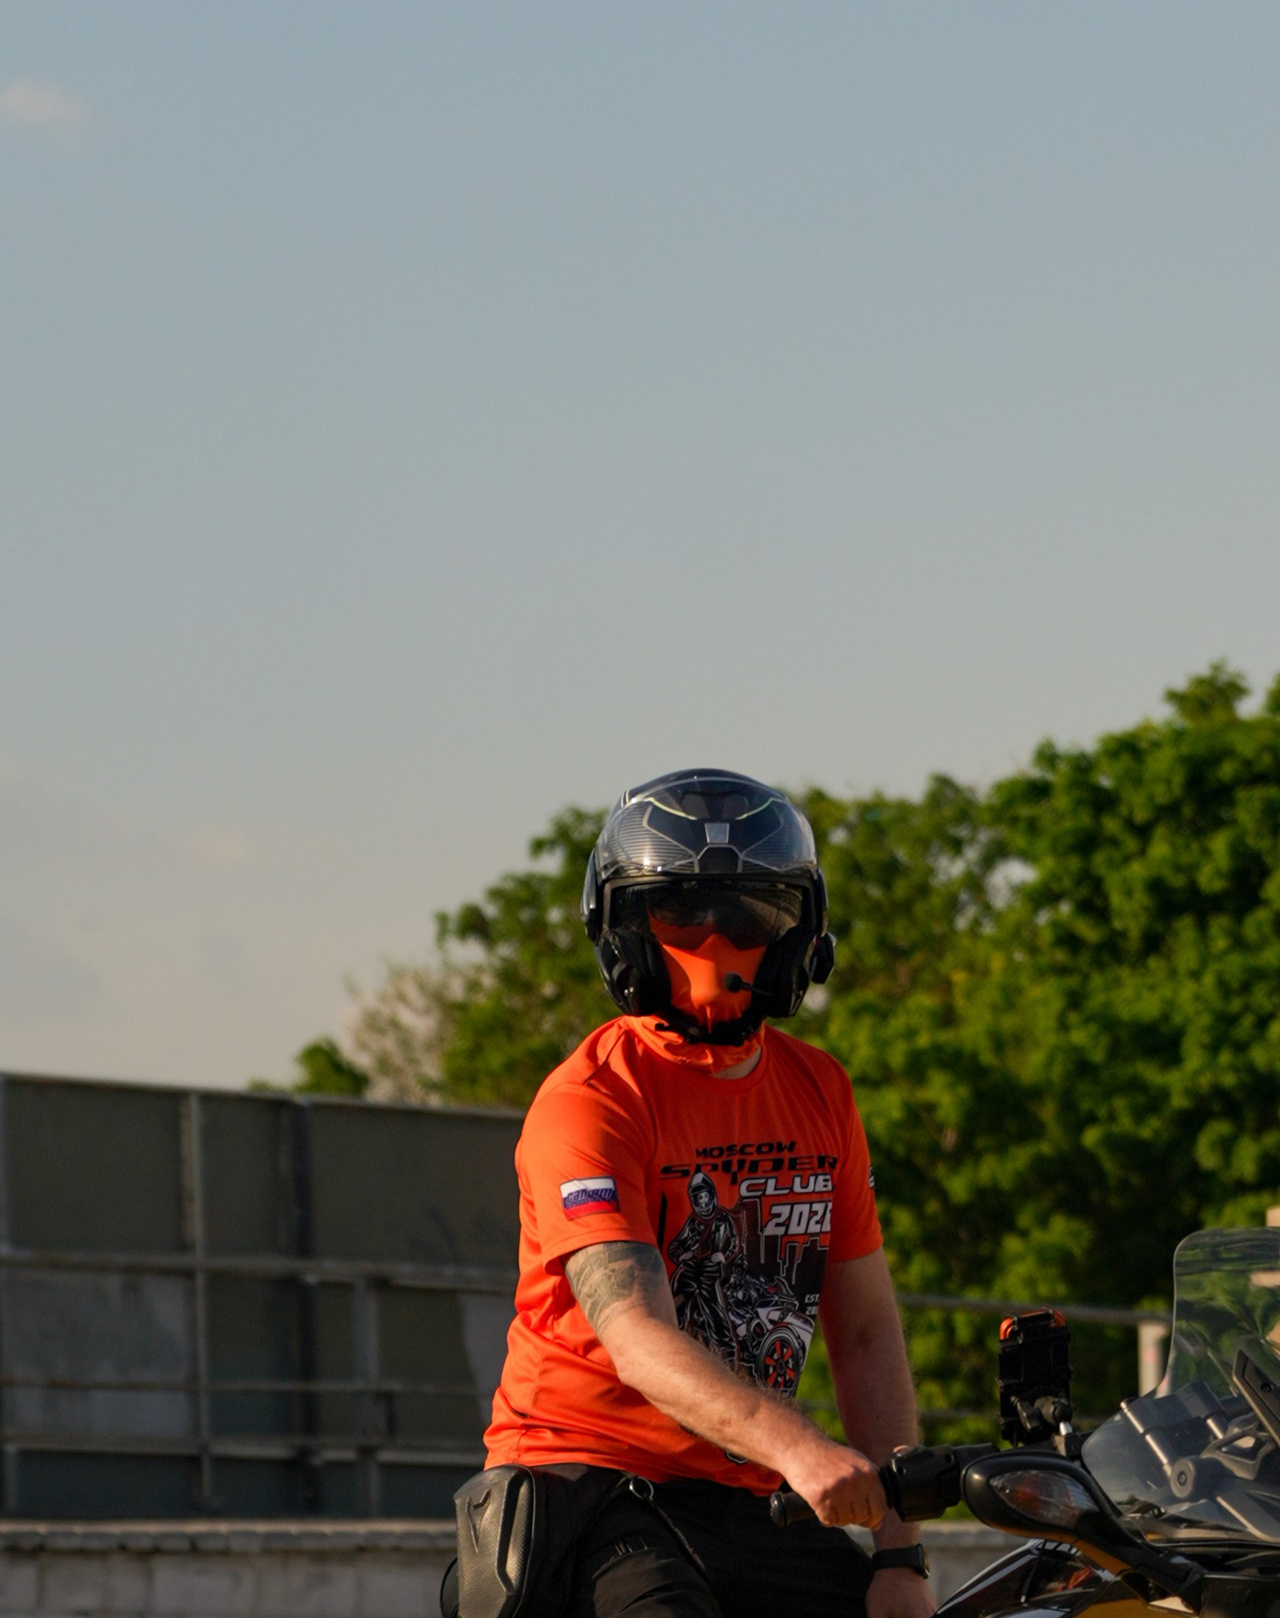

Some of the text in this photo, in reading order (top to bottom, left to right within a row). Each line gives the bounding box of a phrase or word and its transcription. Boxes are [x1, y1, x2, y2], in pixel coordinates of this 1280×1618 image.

[695, 1141, 797, 1159] MOSCOW
[658, 1155, 838, 1185] SPYDER
[739, 1173, 834, 1198] CLUB
